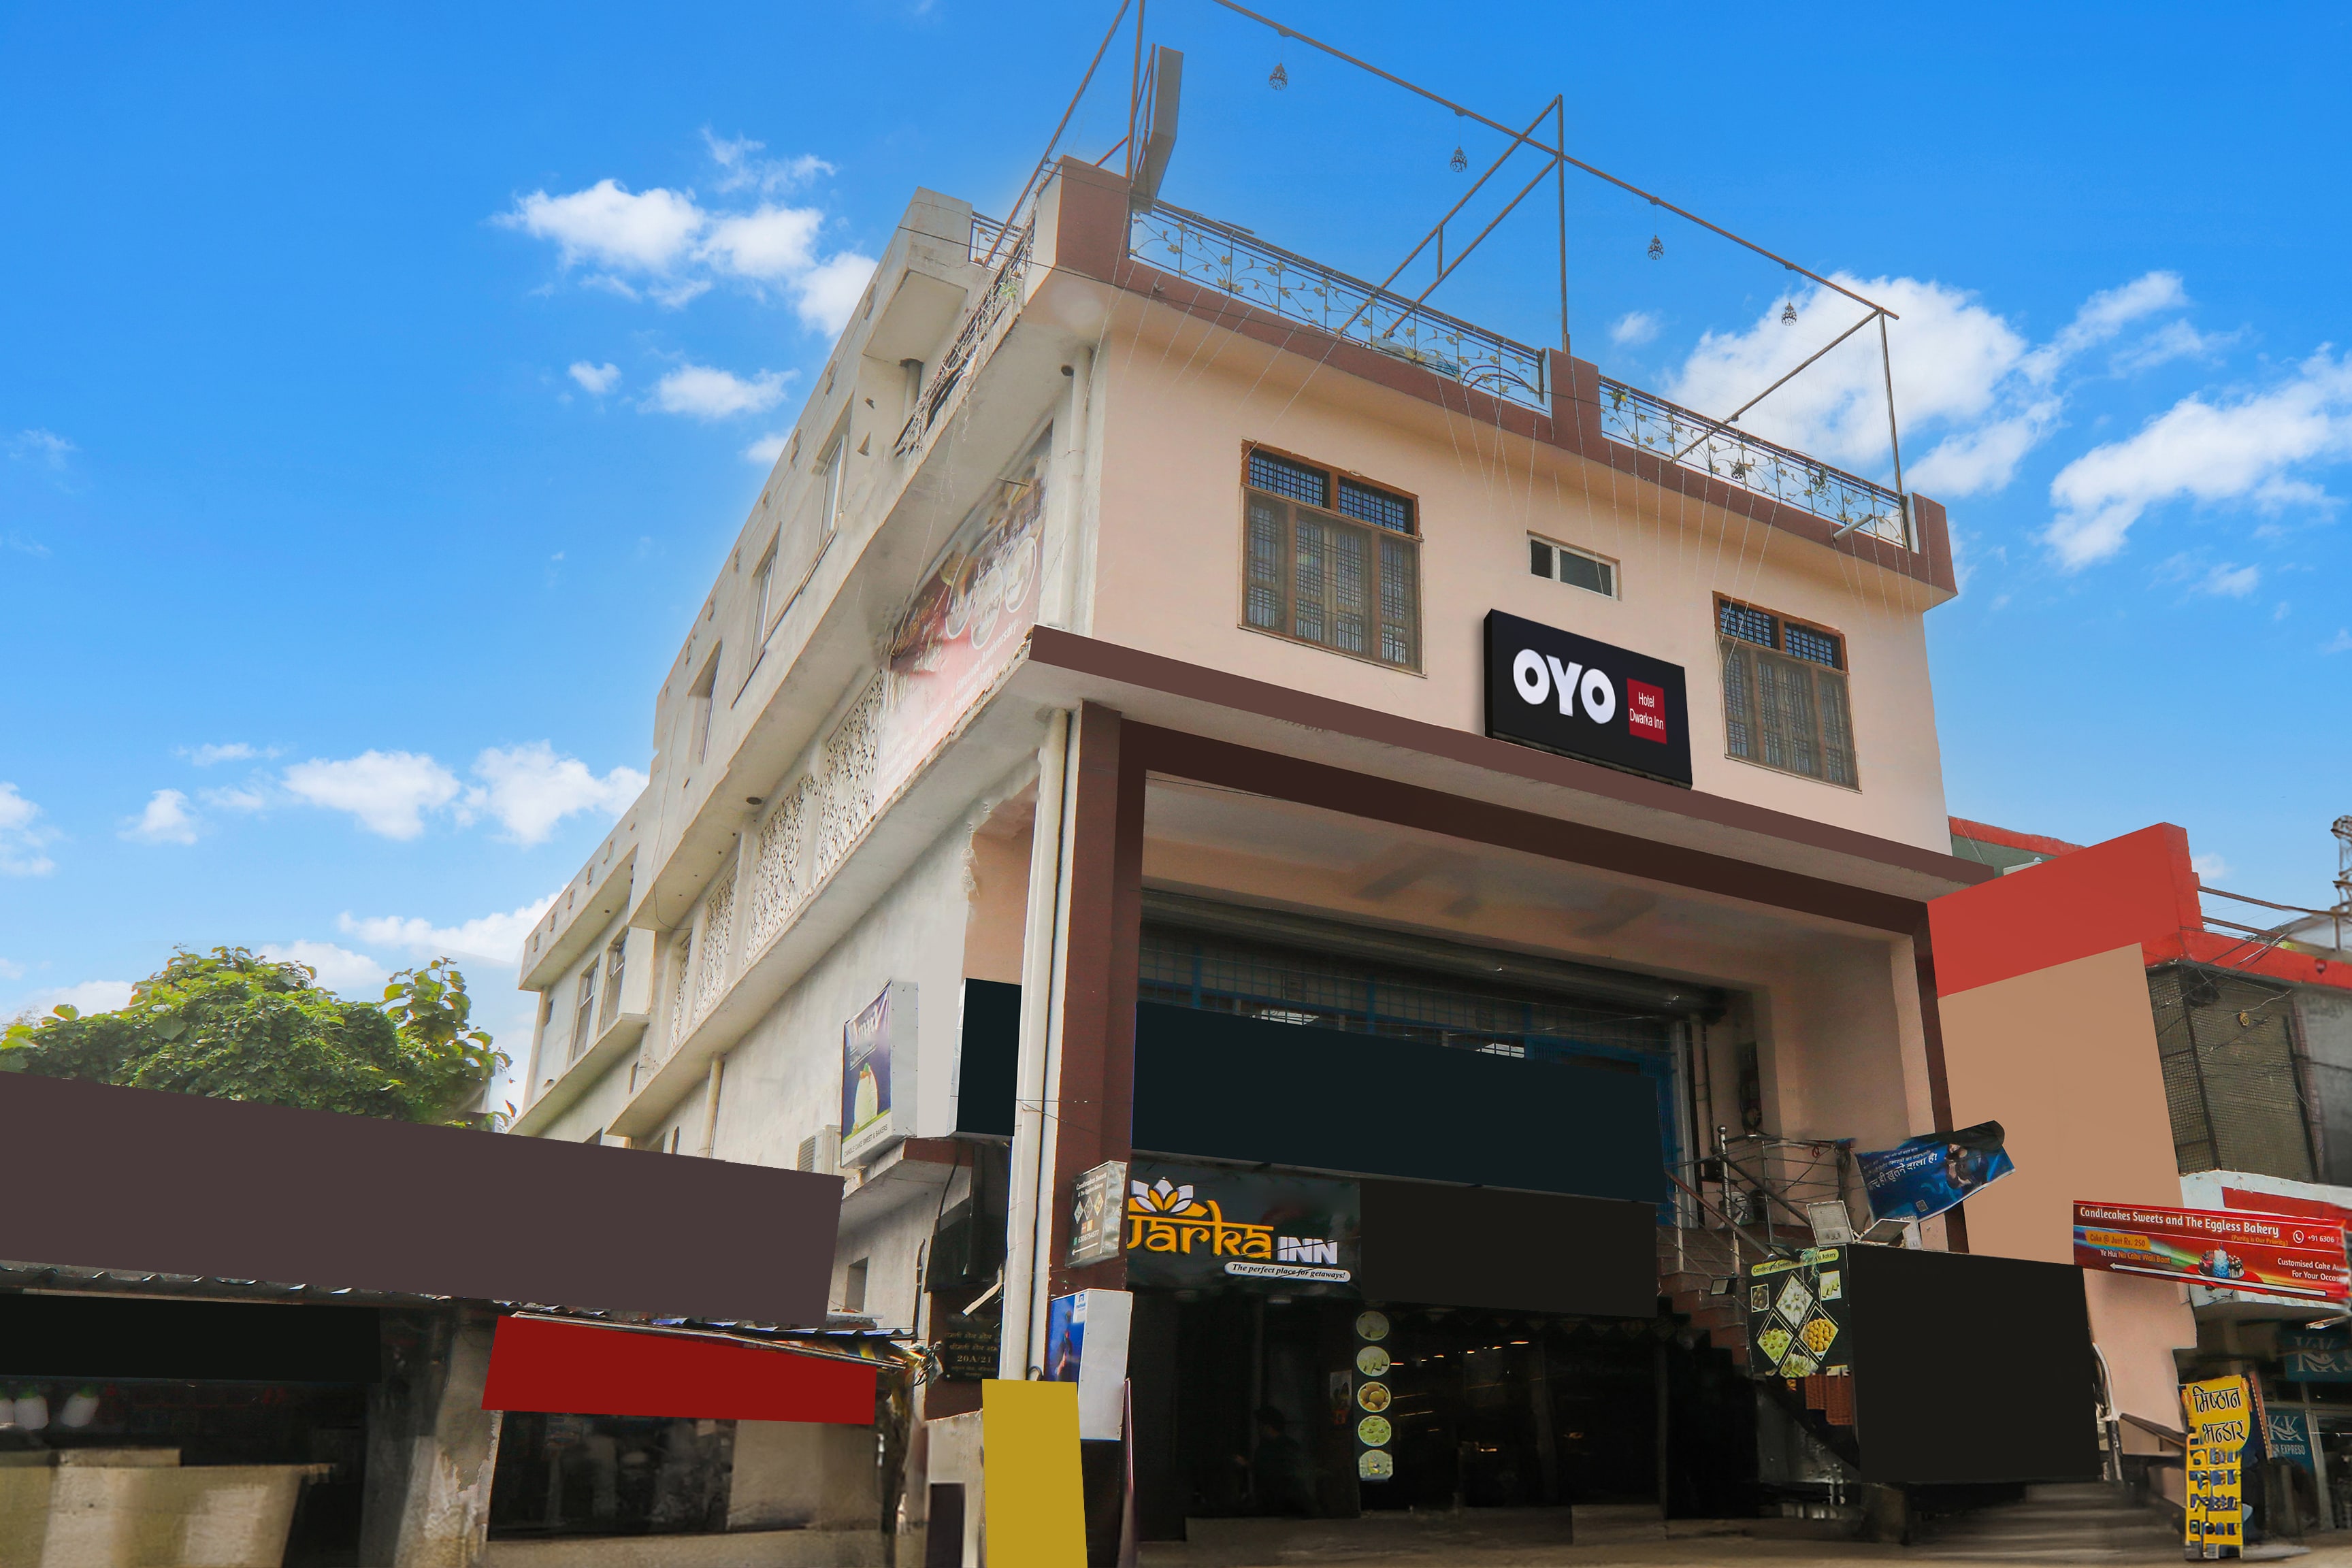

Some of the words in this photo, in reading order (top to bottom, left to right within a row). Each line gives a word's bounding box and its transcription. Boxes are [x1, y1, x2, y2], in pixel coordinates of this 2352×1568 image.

[1513, 649, 1616, 724] OYO
[1638, 691, 1654, 708] Hotel
[1630, 708, 1653, 727] Dwarka
[1654, 715, 1664, 730] Inn
[2080, 1207, 2131, 1221] Candlecakes
[2133, 1211, 2163, 1224] Sweets
[2166, 1215, 2183, 1226] and
[2185, 1216, 2203, 1228] The
[2205, 1218, 2241, 1232] Eggless
[2244, 1222, 2280, 1238] Bakery
[2090, 1234, 2102, 1242] Cake
[2104, 1235, 2110, 1244] @
[2111, 1236, 2123, 1245] Just
[2124, 1237, 2133, 1246] Rs.
[2134, 1239, 2145, 1247] 250
[1277, 1237, 1337, 1265] INN
[1247, 1266, 1275, 1275] perfect
[1275, 1267, 1296, 1275] place
[1296, 1269, 1309, 1277] for
[1311, 1271, 1346, 1280] getaways!
[2277, 1258, 2313, 1269] Customised
[2315, 1262, 2331, 1270] Cake
[2291, 1270, 2302, 1278] For
[2304, 1271, 2319, 1279] Your
[2320, 1273, 2342, 1282] Occasi
[2192, 1385, 2241, 1414] मिष्ठान
